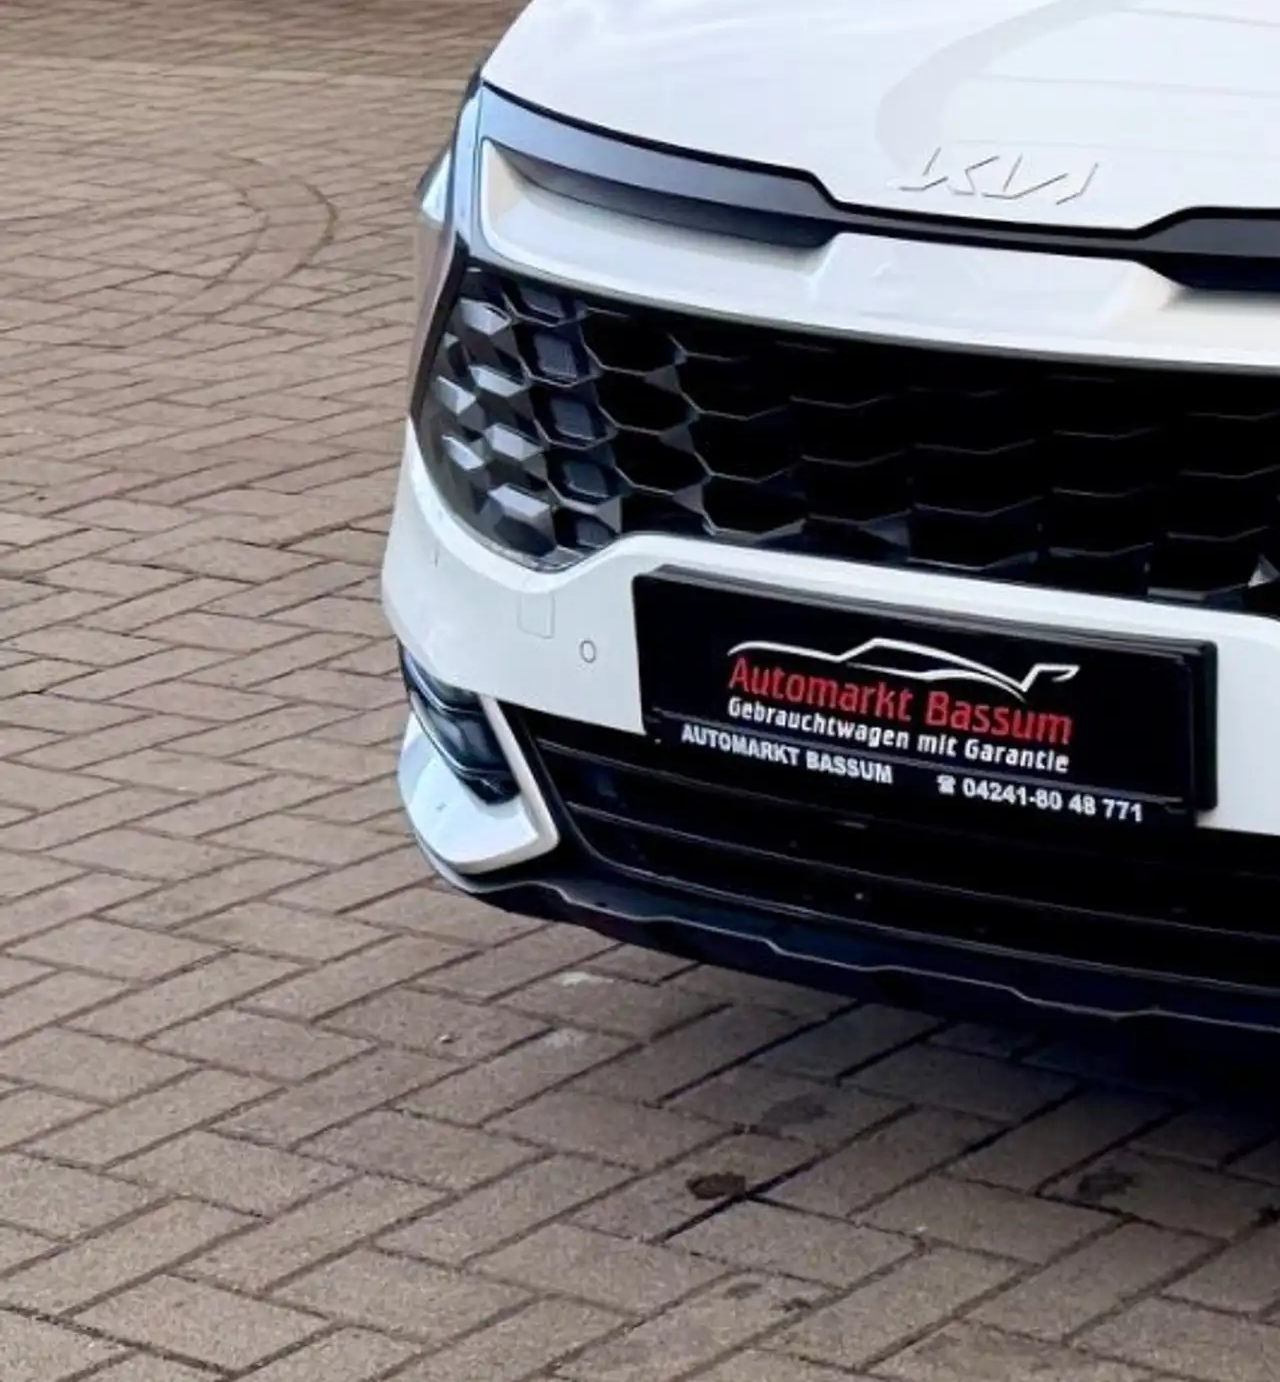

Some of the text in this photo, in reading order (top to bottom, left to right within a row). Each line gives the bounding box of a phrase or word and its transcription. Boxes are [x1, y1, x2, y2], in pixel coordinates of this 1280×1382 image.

[890, 146, 1099, 206] KIA
[728, 657, 1073, 745] Automarkt Bassum
[681, 723, 893, 784] AUTOMARKT BASSUM
[727, 696, 1070, 774] Gebrauchtwagen mit Garantie
[962, 777, 1143, 823] 04241-80 48 771
